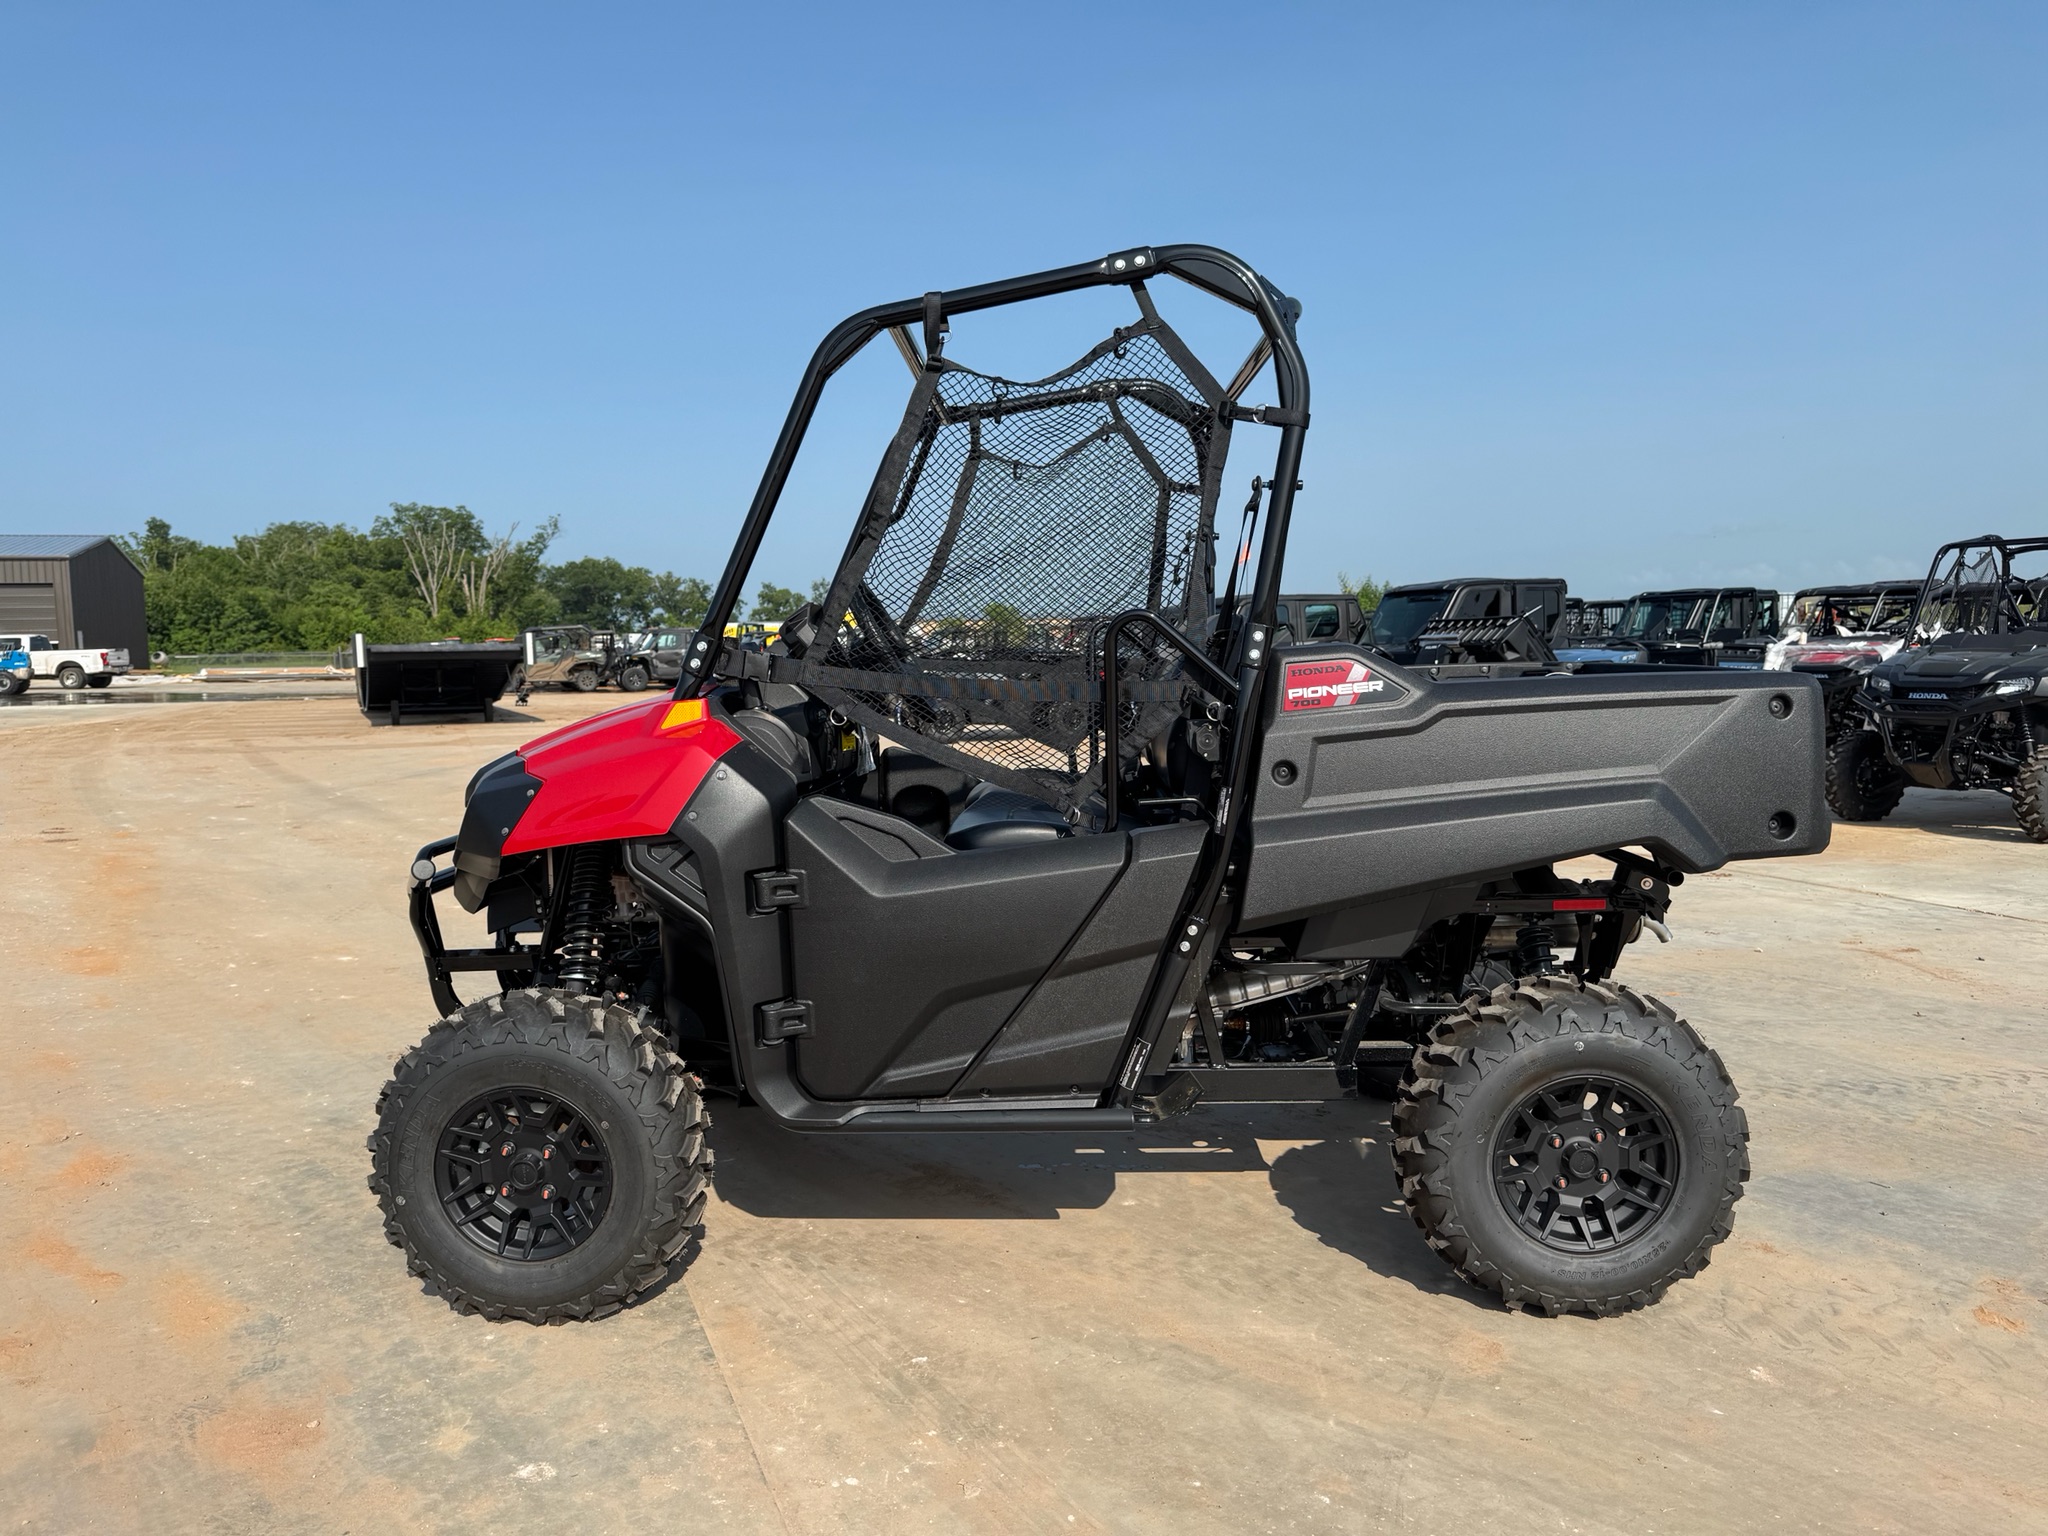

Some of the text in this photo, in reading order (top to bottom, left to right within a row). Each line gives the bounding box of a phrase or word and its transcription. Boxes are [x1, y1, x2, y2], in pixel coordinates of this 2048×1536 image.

[1290, 664, 1346, 677] HONDA
[1287, 680, 1384, 700] PIONEER
[1908, 692, 1949, 700] HONDA
[1290, 698, 1321, 708] 700
[1664, 1074, 1718, 1174] KENDA
[399, 1093, 440, 1193] KENDA
[1557, 1268, 1587, 1280] NHS
